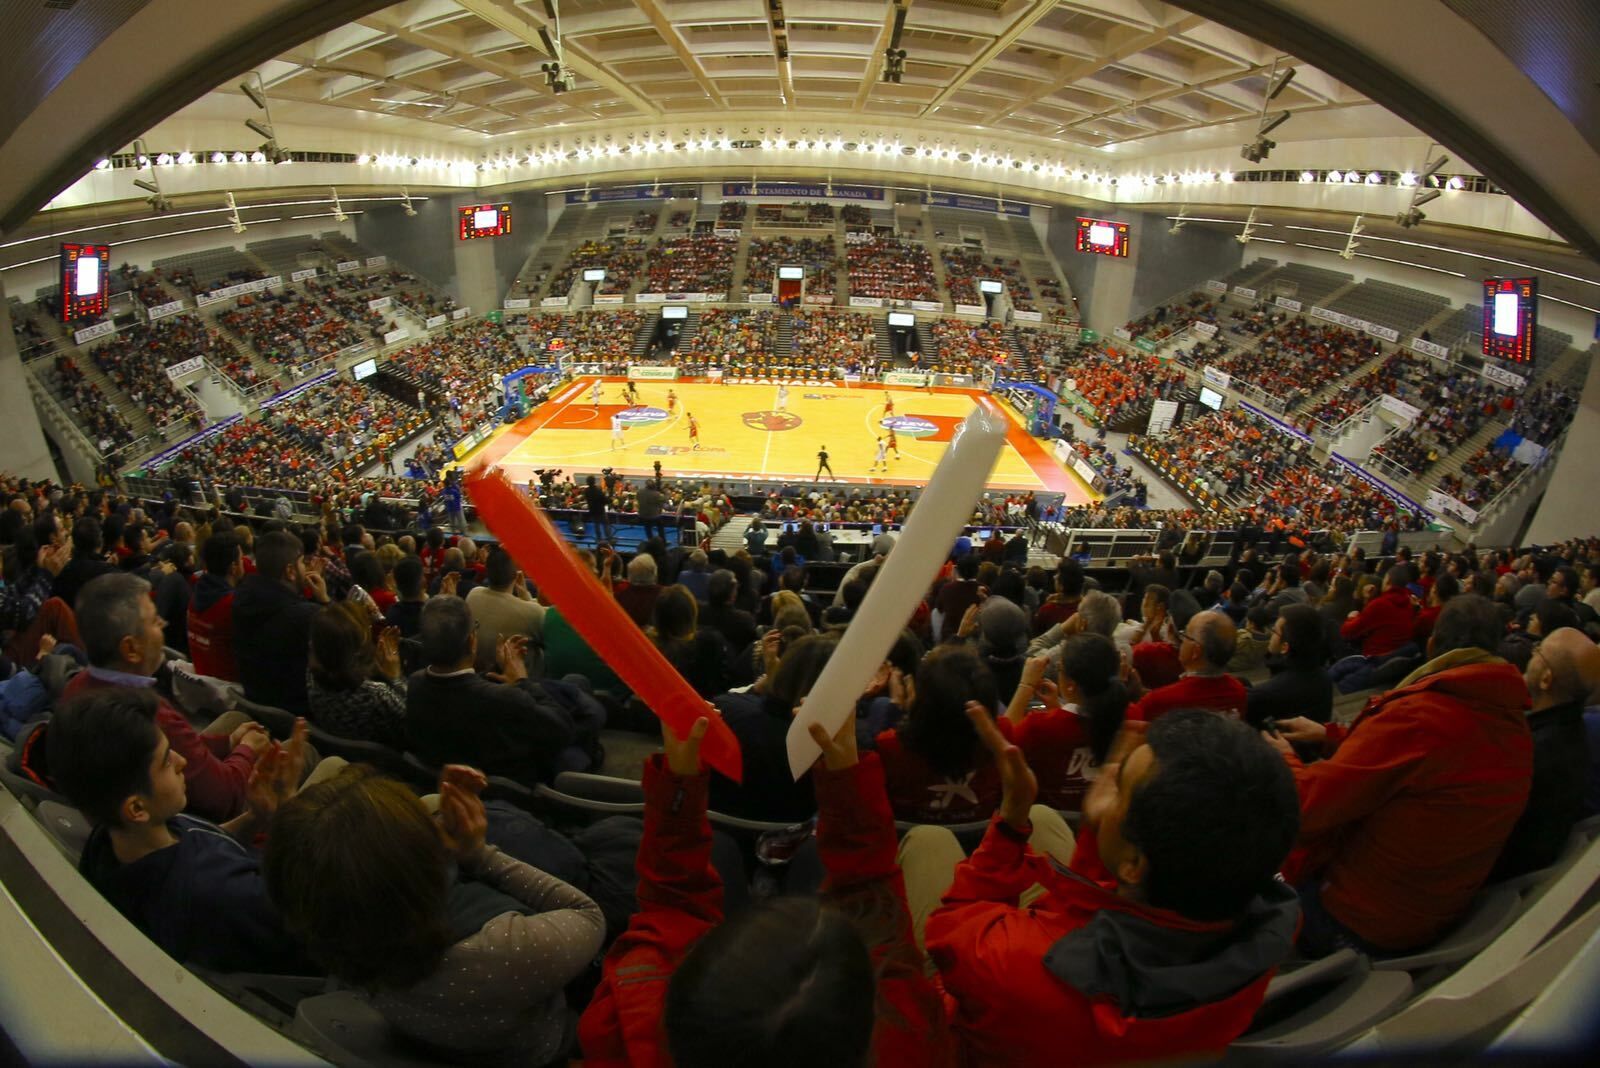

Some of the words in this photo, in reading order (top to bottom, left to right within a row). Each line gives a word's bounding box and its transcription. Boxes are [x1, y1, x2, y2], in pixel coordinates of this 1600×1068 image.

[740, 186, 808, 196] AYNTAMIENTO
[256, 276, 280, 290] IDEAL
[151, 302, 182, 316] IDEAL
[79, 323, 112, 341] IDEAL
[1368, 323, 1395, 339] IDEAL
[1415, 340, 1446, 358] IDEAL
[168, 357, 203, 378] IDEAL
[722, 377, 838, 388] GRANADA
